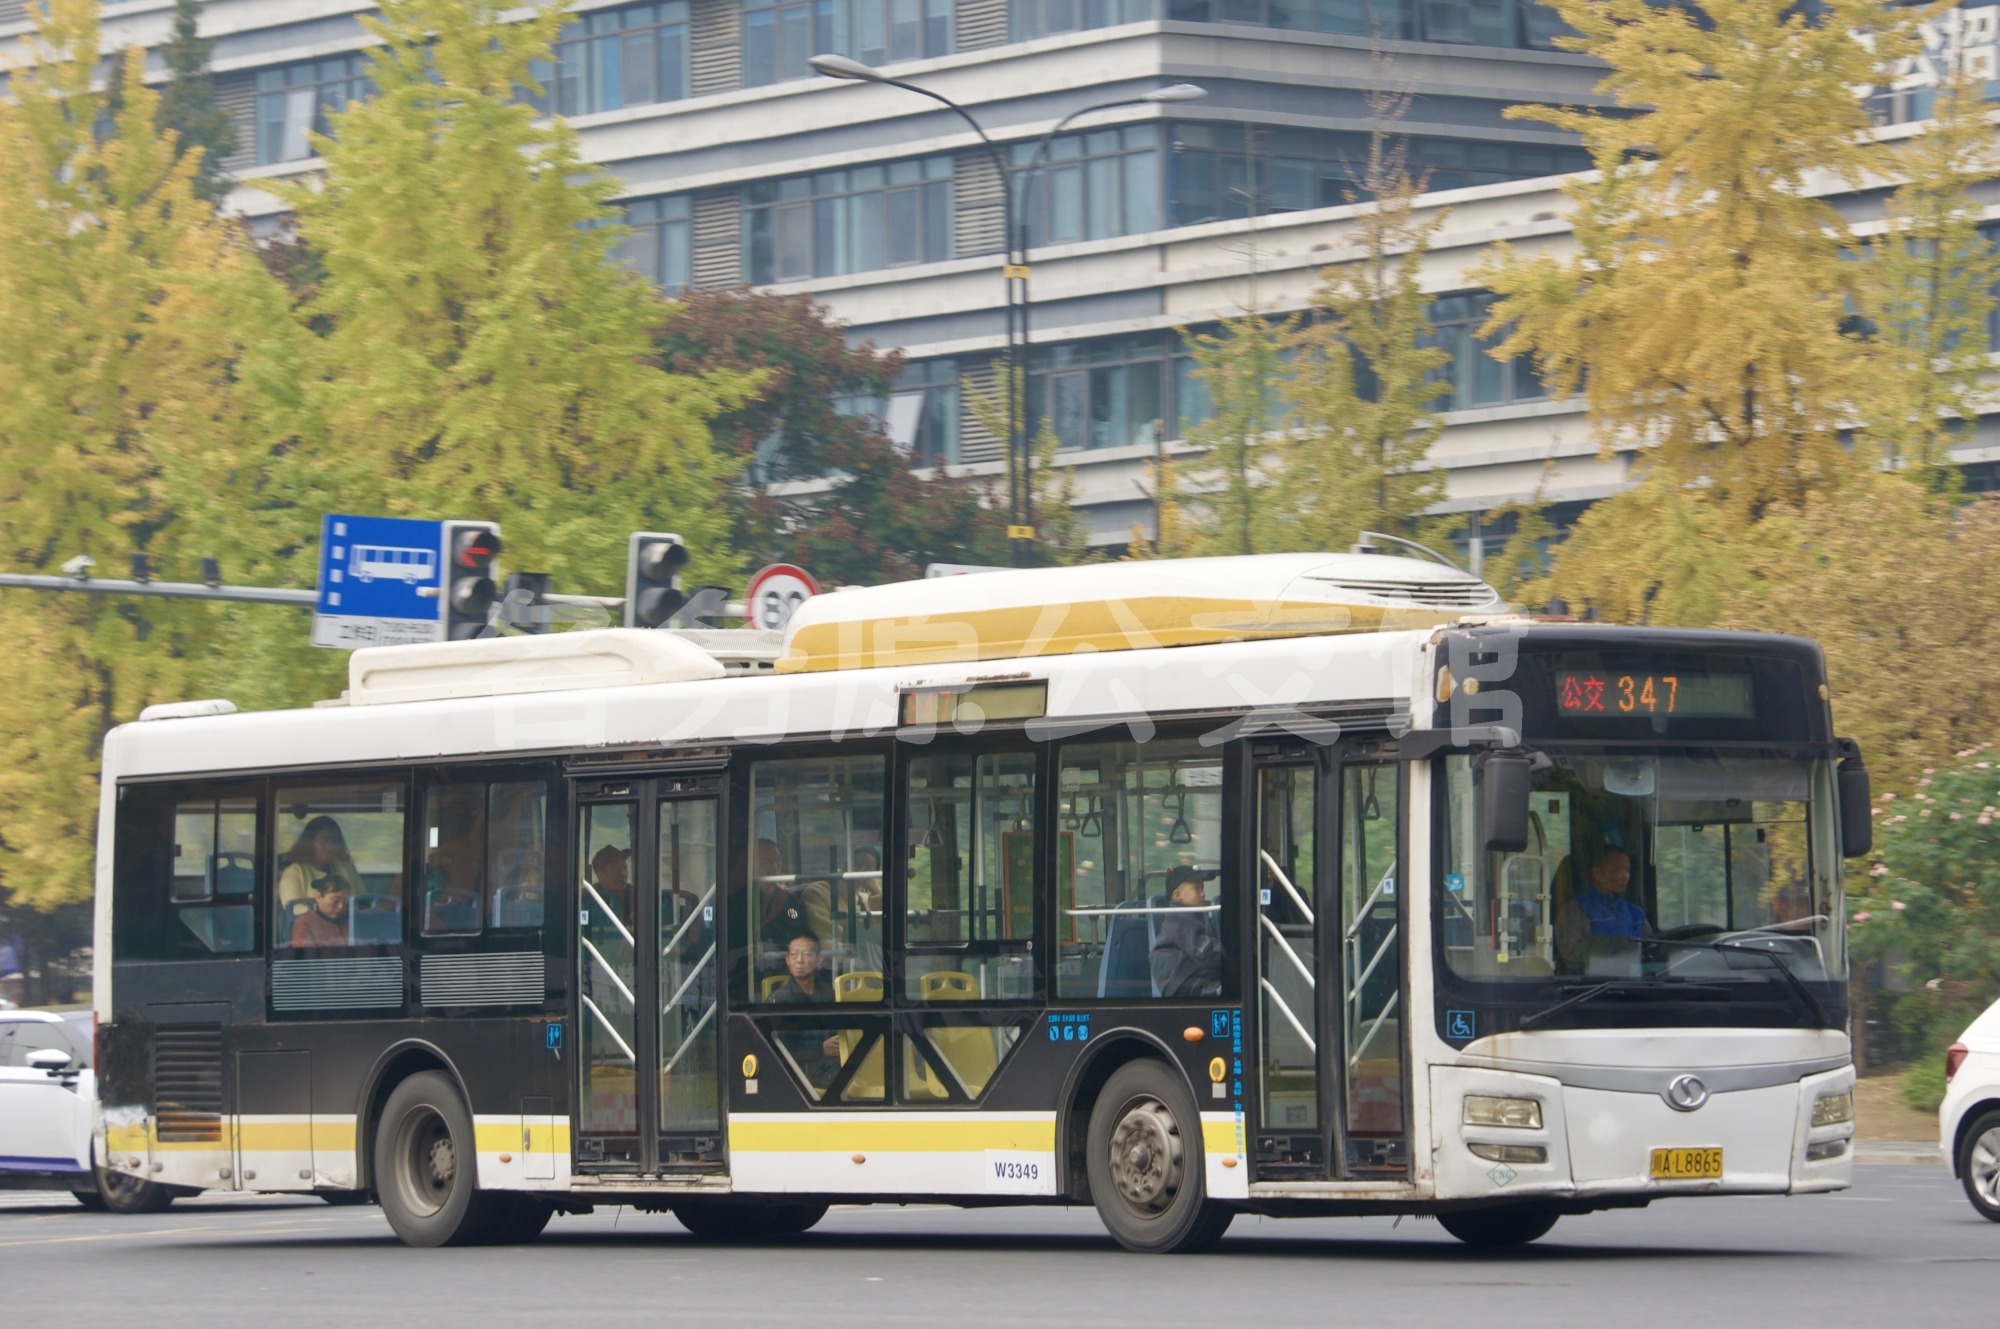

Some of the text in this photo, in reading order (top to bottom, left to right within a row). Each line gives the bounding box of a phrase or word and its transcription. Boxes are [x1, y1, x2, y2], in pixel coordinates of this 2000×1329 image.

[1560, 675, 1678, 712] 公交 347
[994, 1161, 1038, 1180] W3349
[1491, 1169, 1514, 1180] CNG
